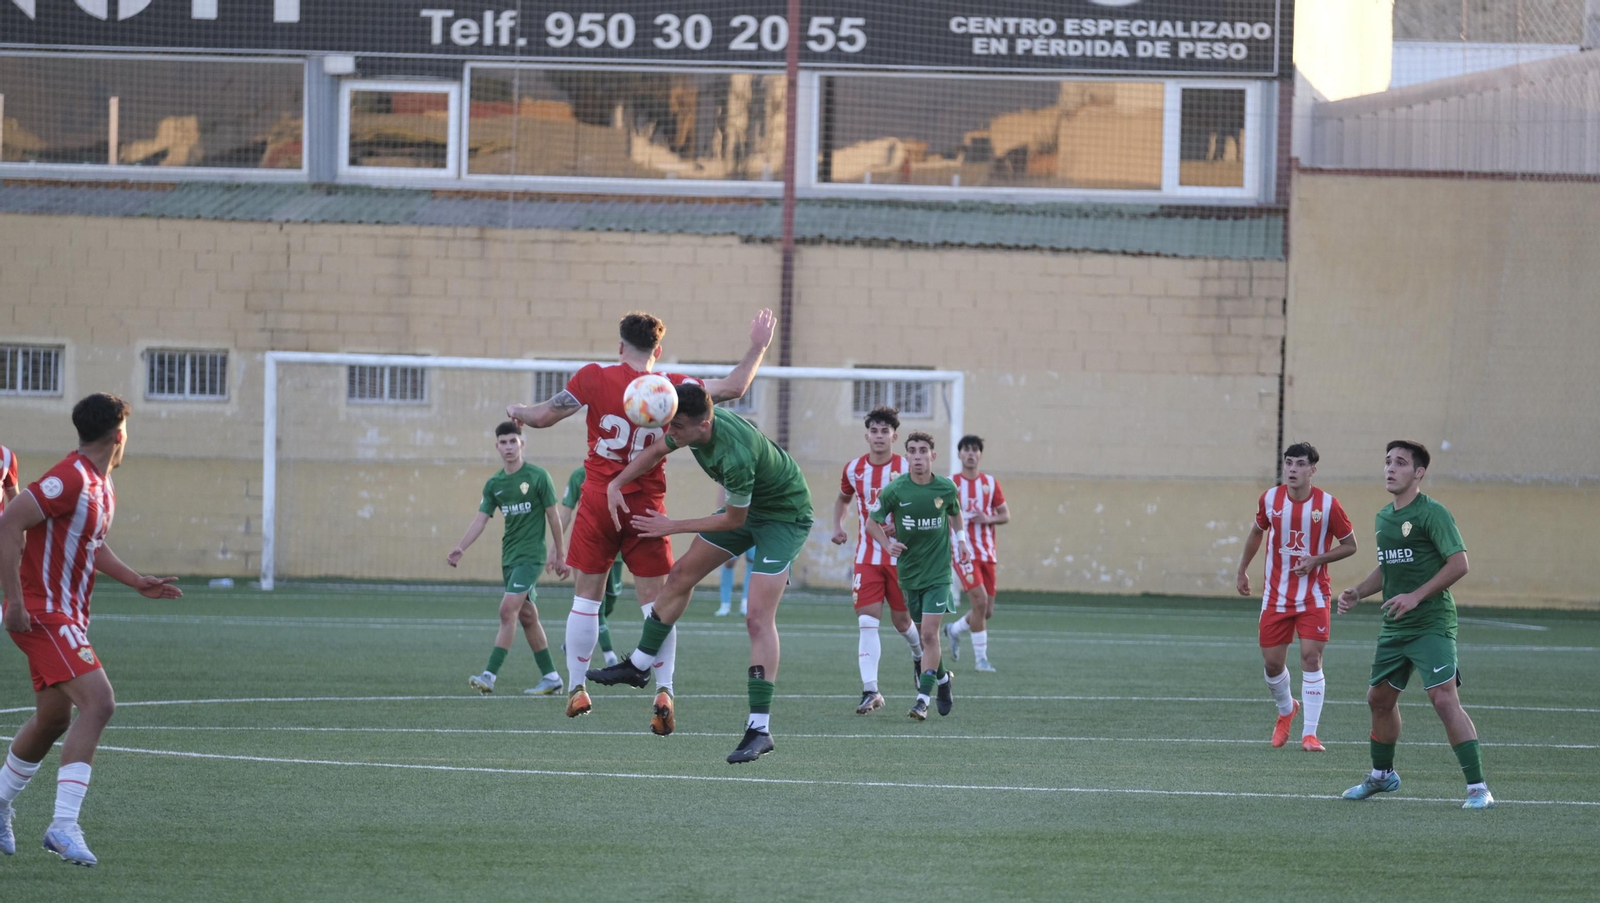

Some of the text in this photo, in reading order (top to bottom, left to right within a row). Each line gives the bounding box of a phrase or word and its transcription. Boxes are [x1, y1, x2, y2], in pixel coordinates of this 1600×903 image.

[420, 9, 867, 53] Telf. 950 30 20 55
[949, 16, 1272, 40] CENTRO ESPECIALIZADO
[972, 35, 1248, 60] EN PÉRDIDA DE PESO
[594, 413, 665, 464] 20
[509, 502, 532, 512] IMED
[917, 517, 942, 527] IMED
[1284, 531, 1306, 549] JK
[1385, 548, 1413, 560] IMED
[58, 624, 91, 650] 18
